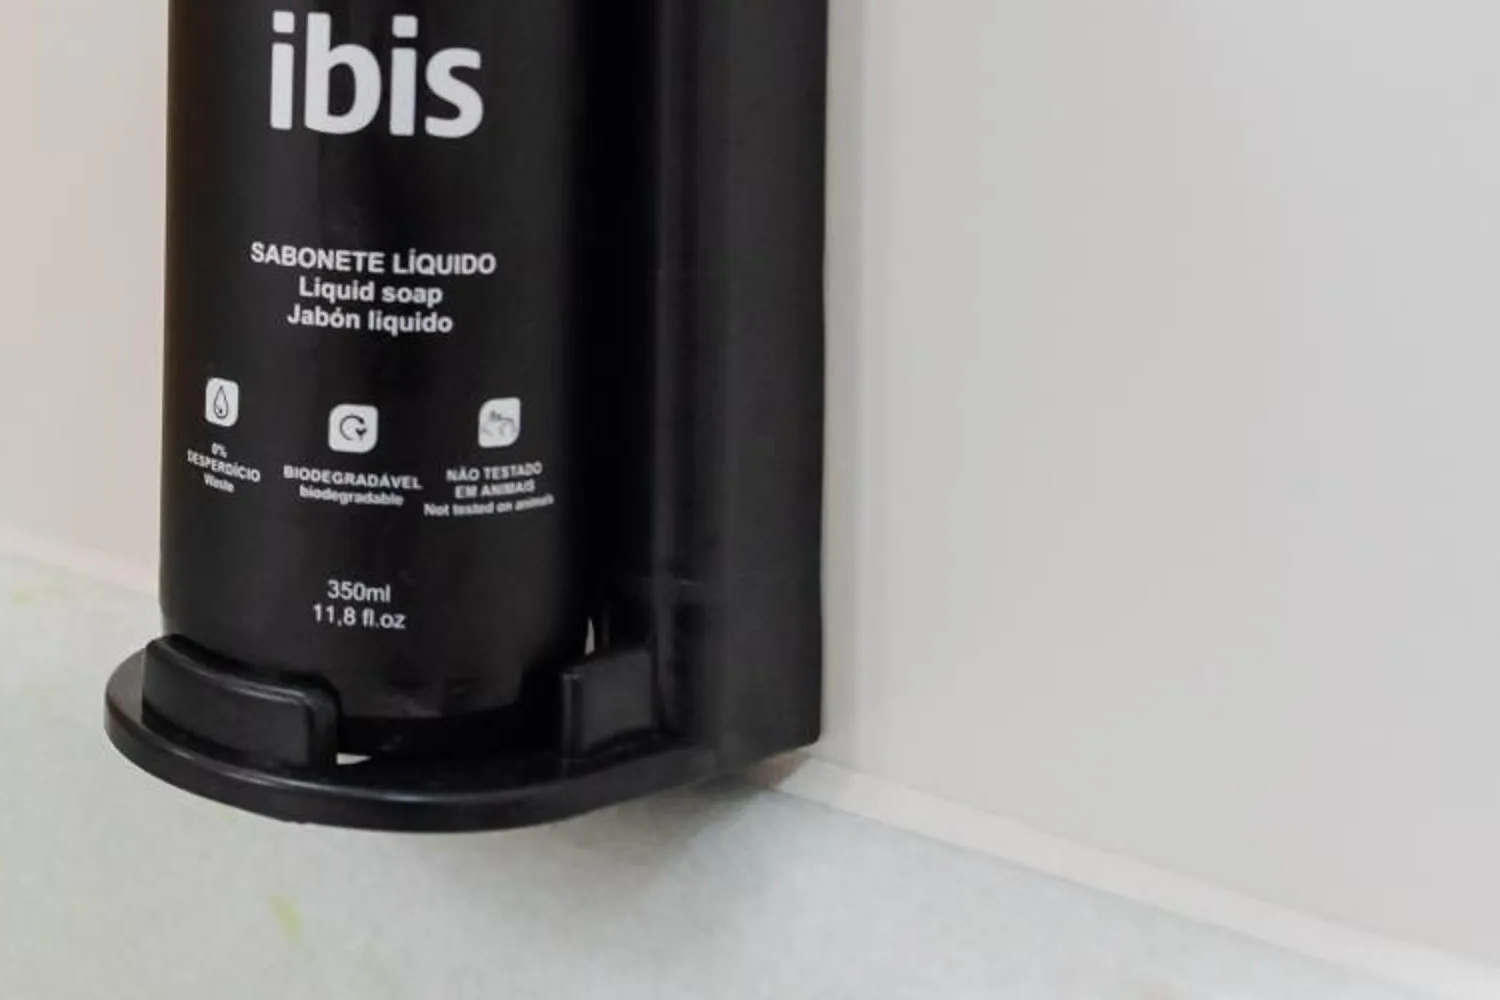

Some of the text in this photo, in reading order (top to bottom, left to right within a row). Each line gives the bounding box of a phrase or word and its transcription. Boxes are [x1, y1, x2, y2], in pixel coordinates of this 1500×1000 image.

[269, 10, 484, 138] ibis
[250, 241, 497, 276] SABONETE LÍQUIDO
[298, 276, 444, 307] Liquid soap
[287, 303, 361, 329] Jabón
[283, 465, 423, 490] BIODEGRADÁVEL
[445, 461, 543, 482] NÃO TESTADO
[299, 484, 405, 506] biodegradable
[454, 478, 536, 499] EM ANIMAIS
[423, 503, 450, 517] Not
[452, 501, 495, 516] tested
[327, 579, 392, 602] 350ml
[313, 604, 406, 629] 11,8 fl.oz
